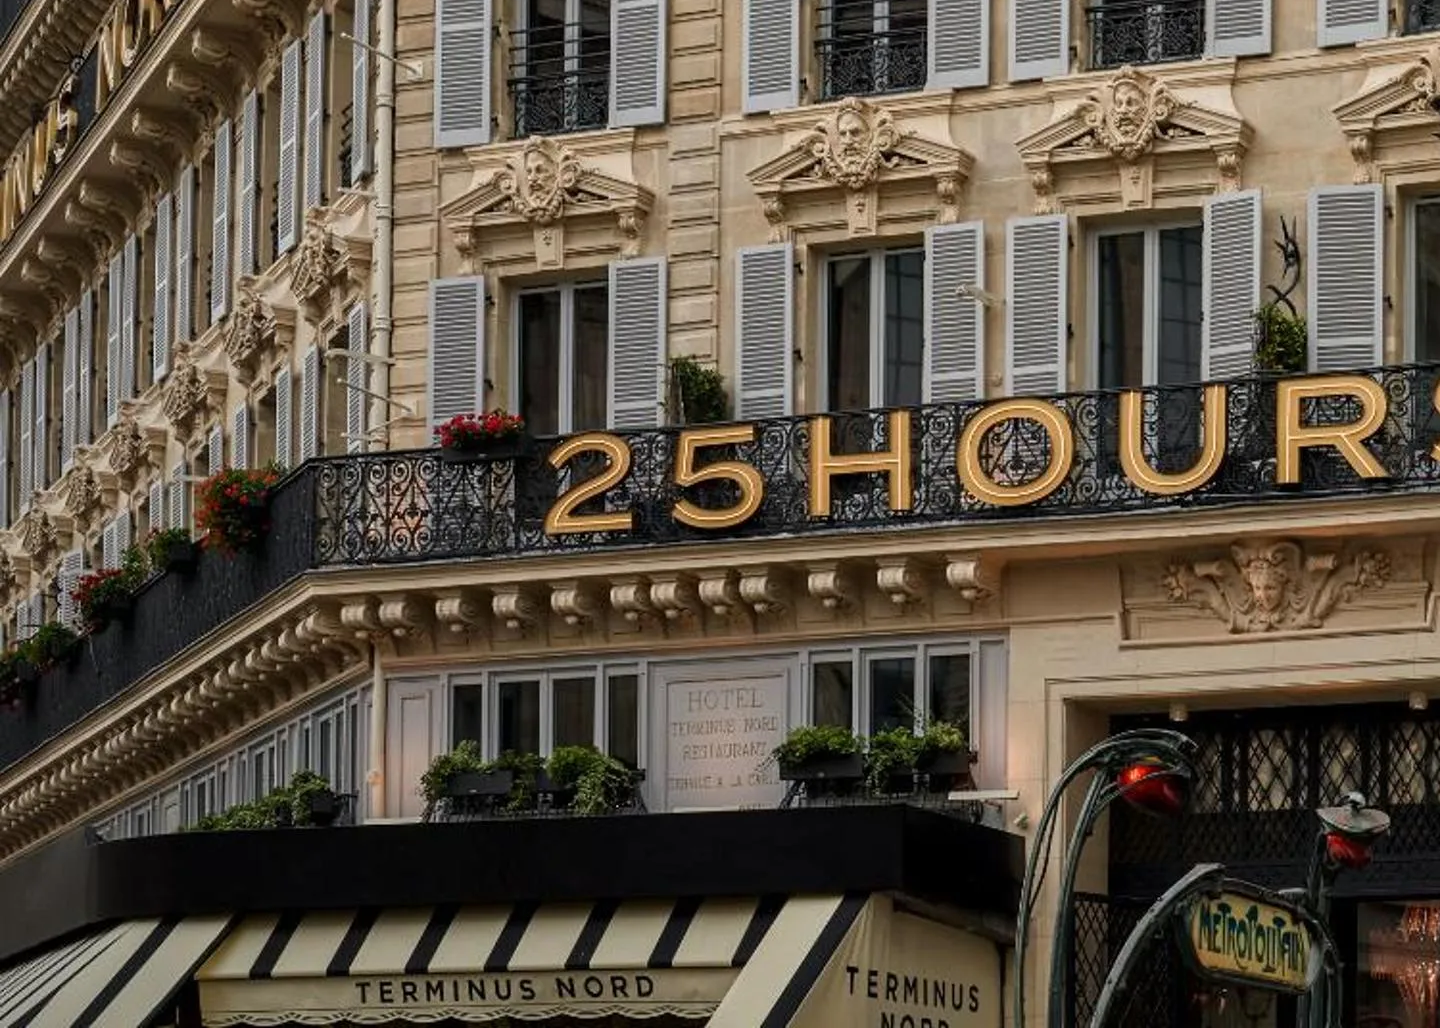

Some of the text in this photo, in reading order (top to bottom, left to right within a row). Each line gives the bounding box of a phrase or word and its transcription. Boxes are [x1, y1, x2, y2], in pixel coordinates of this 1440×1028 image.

[687, 687, 765, 712] HOTEL
[682, 742, 767, 761] RESTAURANT
[355, 975, 655, 1004] TERMINUS NORD
[846, 965, 980, 1013] TERMINUS
